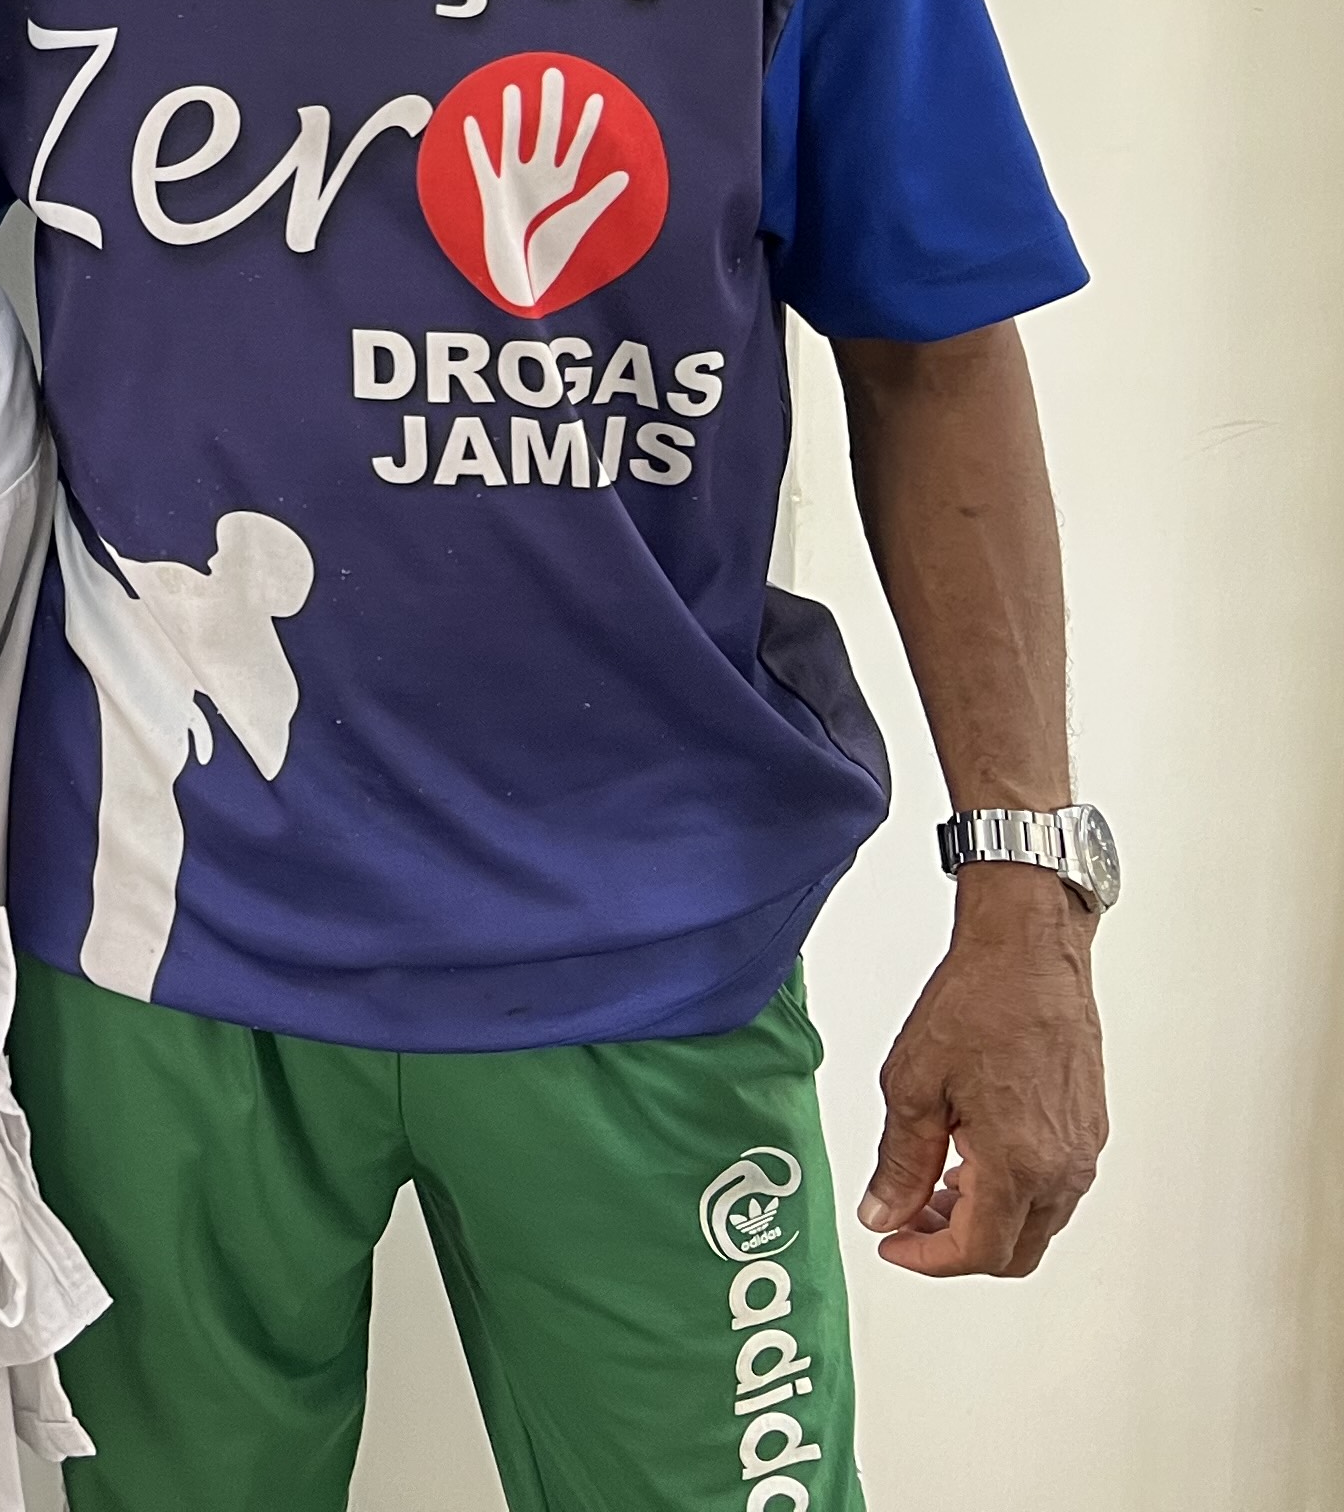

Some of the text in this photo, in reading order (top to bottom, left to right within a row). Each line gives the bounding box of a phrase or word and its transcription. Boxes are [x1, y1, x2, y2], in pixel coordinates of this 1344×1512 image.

[352, 328, 725, 418] DROGAS
[371, 414, 697, 489] JAMIS
[740, 1227, 782, 1252] adidas
